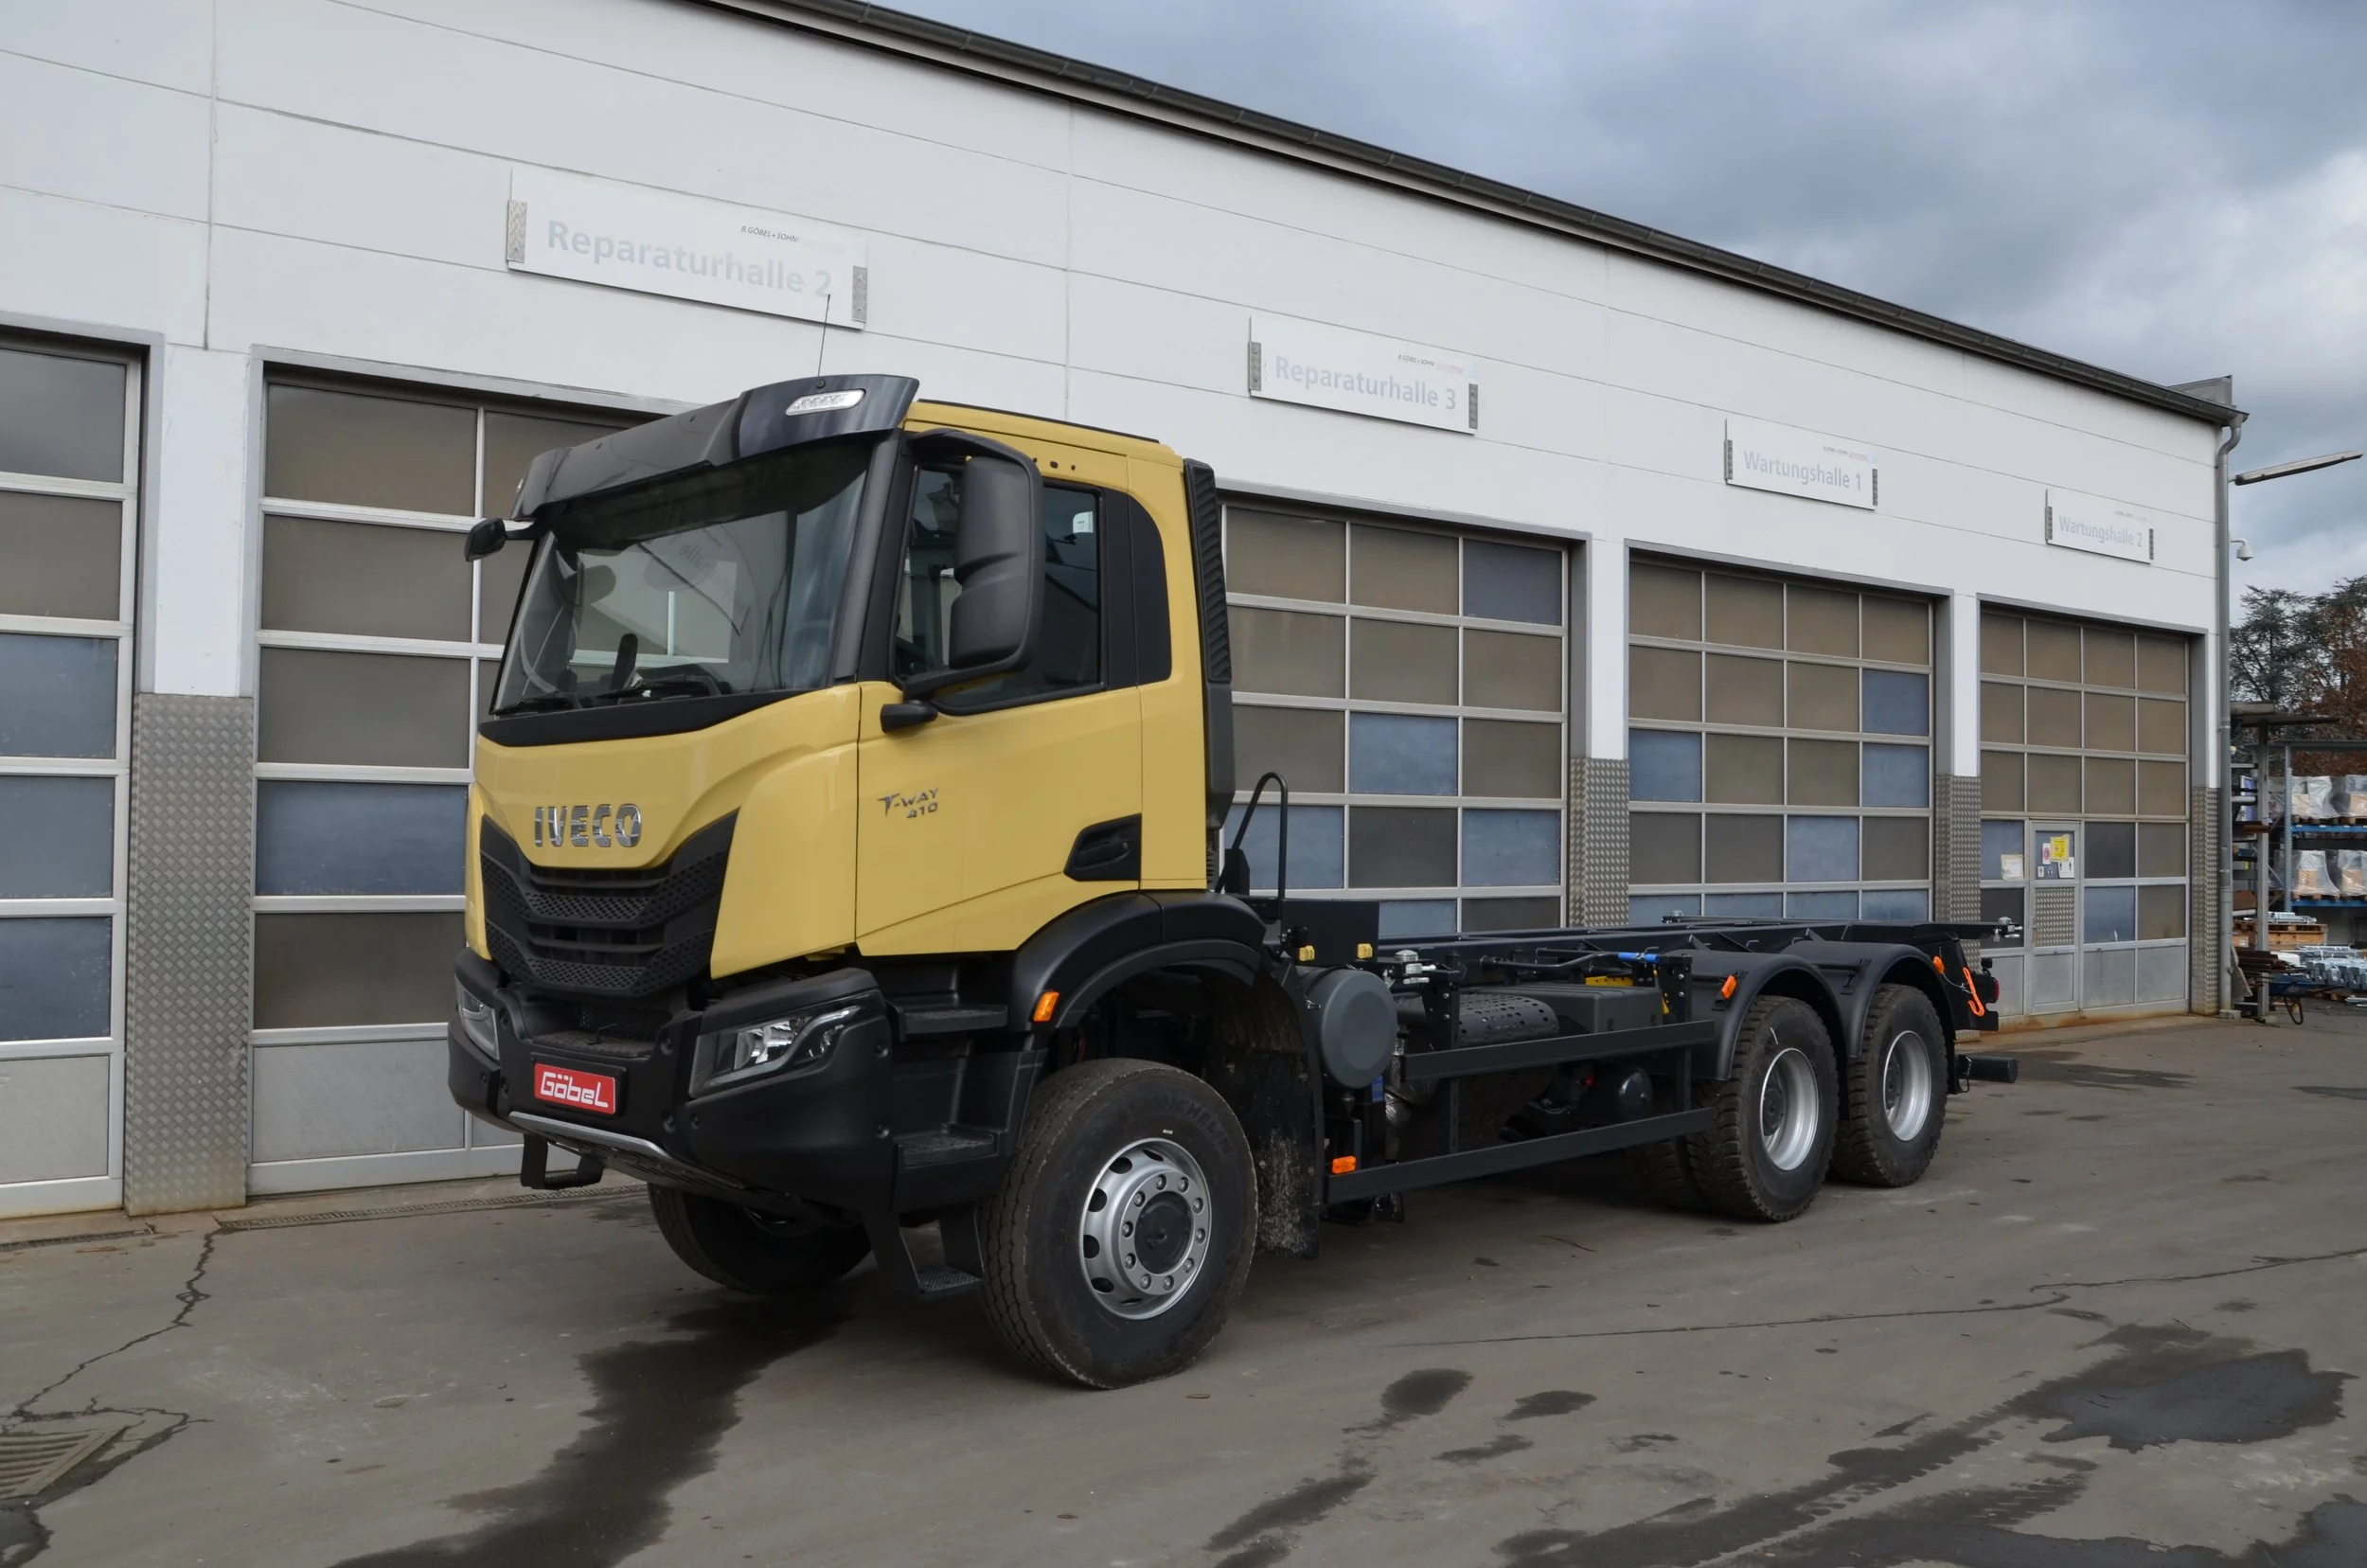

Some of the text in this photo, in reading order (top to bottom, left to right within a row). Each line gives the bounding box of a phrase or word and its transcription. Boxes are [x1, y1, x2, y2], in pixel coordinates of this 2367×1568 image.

[547, 219, 832, 297] Reparaturhalle 2
[1275, 355, 1456, 410] Reparaturhalle 3
[1744, 451, 1862, 491] Wartungshalle 1
[2059, 514, 2135, 545] Wartungshalle
[2137, 532, 2144, 547] 2
[877, 788, 939, 816] T-WAY
[906, 802, 938, 819] 410
[534, 803, 642, 847] IVECO
